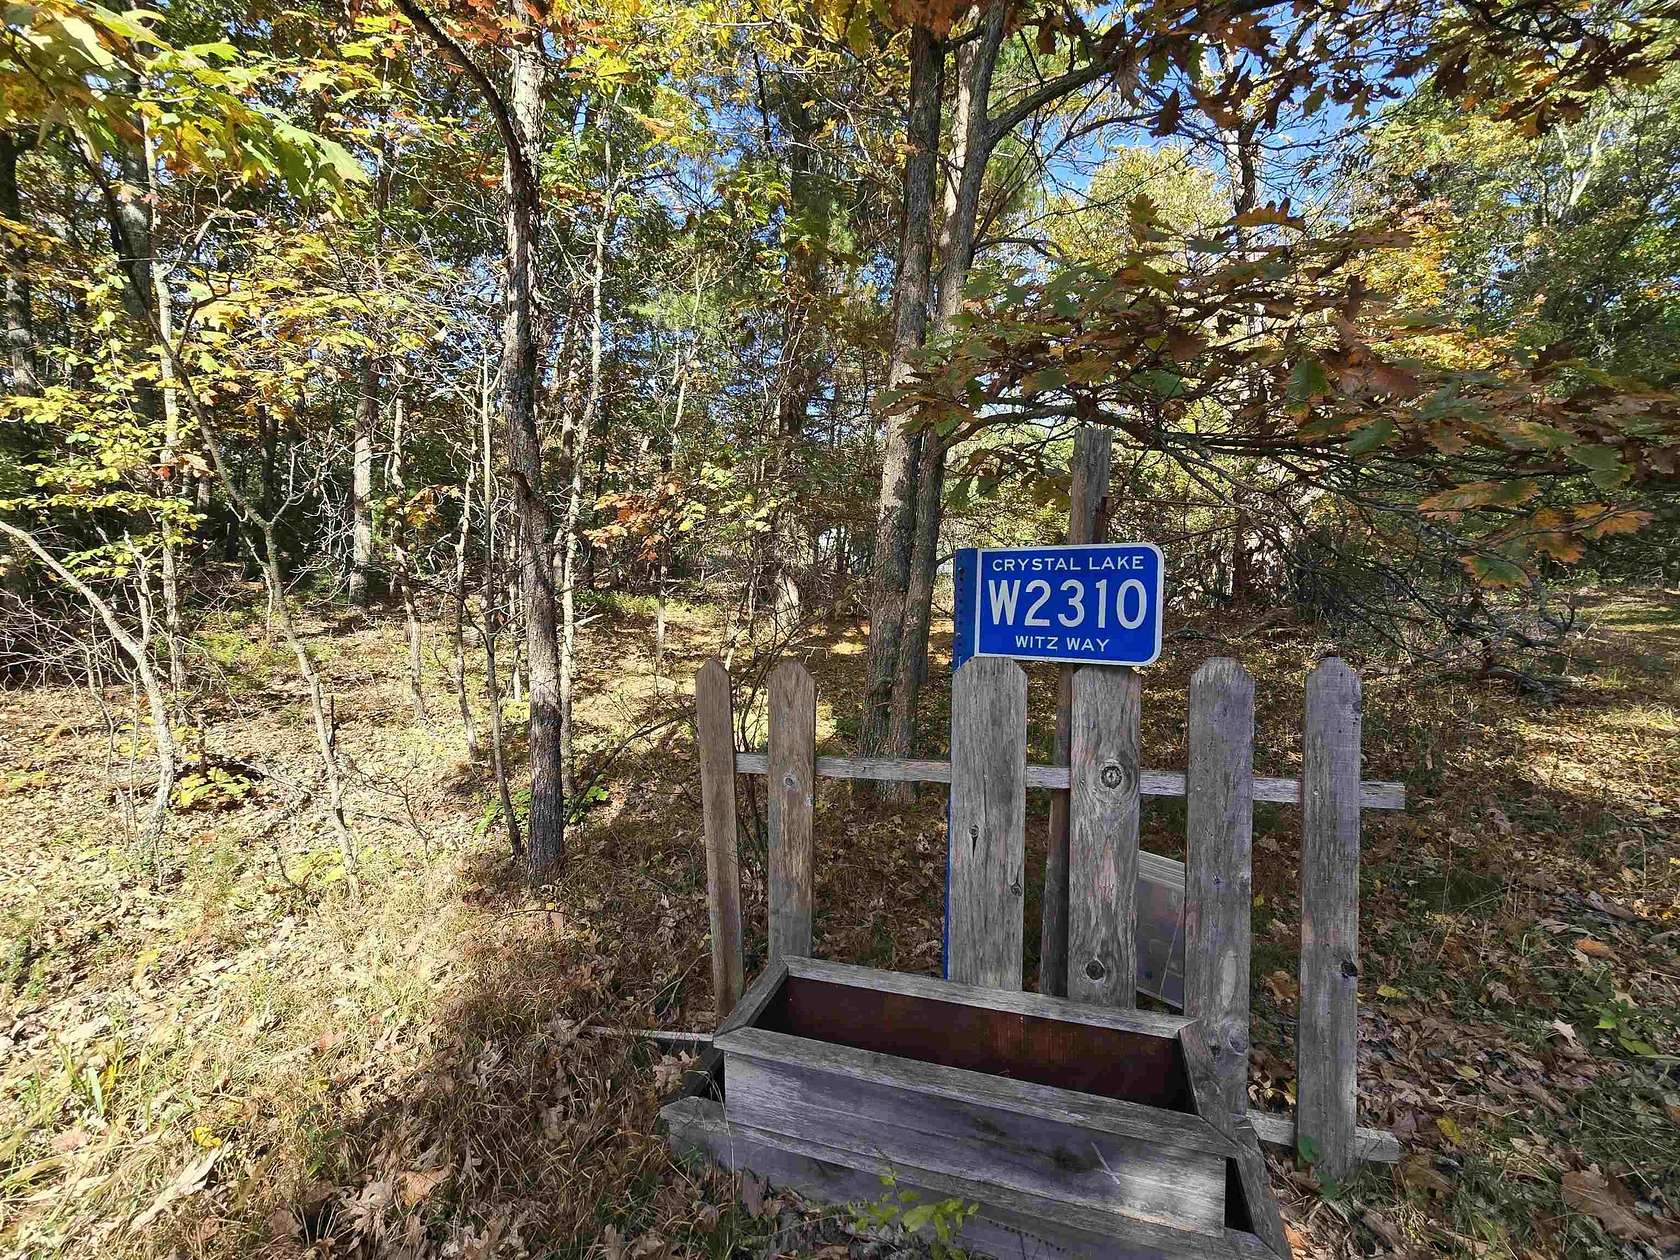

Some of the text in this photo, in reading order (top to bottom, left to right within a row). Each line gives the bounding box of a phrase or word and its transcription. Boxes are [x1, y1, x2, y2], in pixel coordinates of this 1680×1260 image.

[992, 556, 1144, 571] CRYSTAL LAKE
[988, 578, 1147, 629] W2310
[1015, 635, 1110, 652] WITZ WAY
